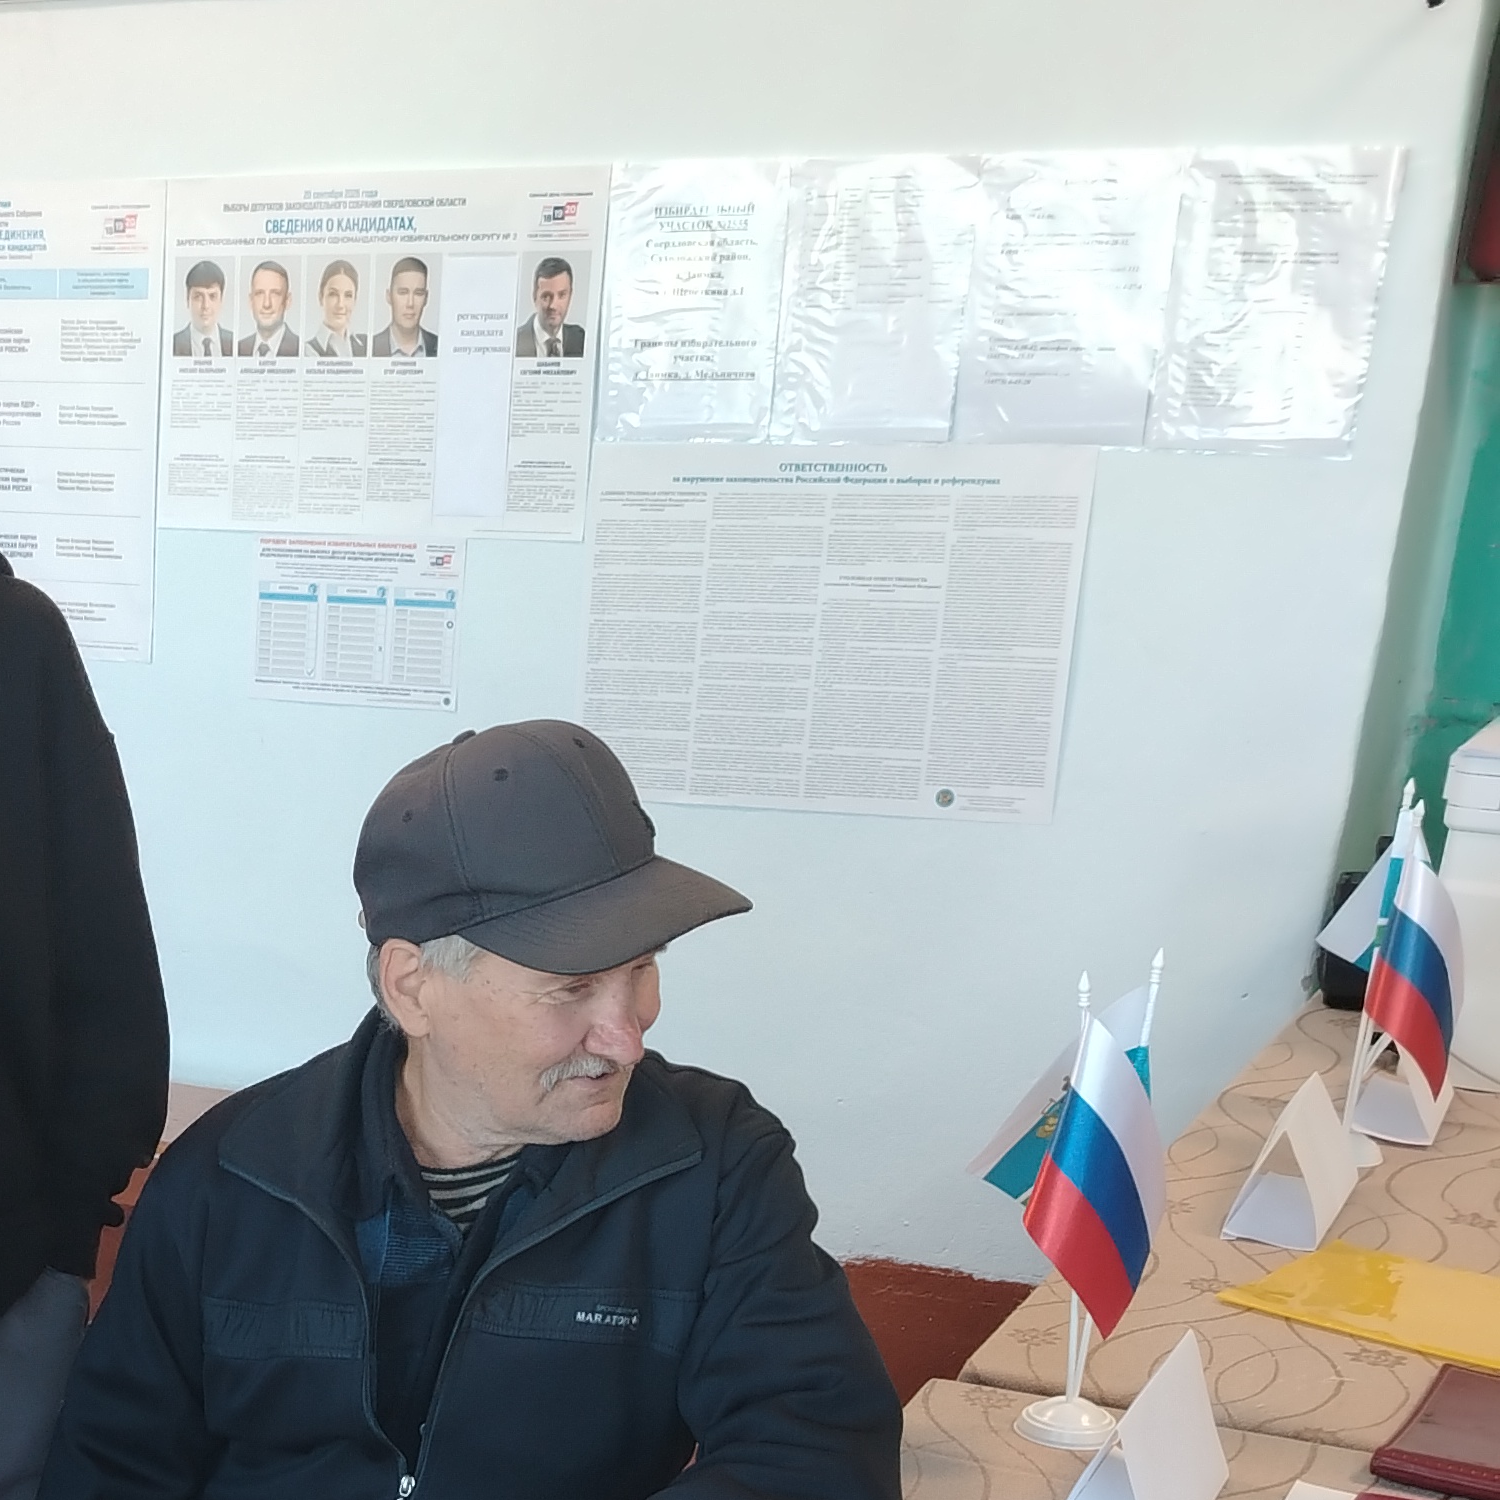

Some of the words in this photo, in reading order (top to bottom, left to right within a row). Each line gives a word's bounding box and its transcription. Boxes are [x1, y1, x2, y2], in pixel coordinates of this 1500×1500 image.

[265, 218, 323, 235] СВЕДЕНИЯ
[326, 218, 334, 232] О
[337, 216, 418, 233] КАНДИДАТАХ,
[658, 219, 714, 231] УЧАСТОК
[456, 312, 509, 321] регистрация
[460, 329, 504, 337] кандидата
[778, 463, 888, 473] ОТВЕТСТВЕННОСТЬ
[795, 475, 841, 484] Российской
[842, 476, 888, 485] Федерации
